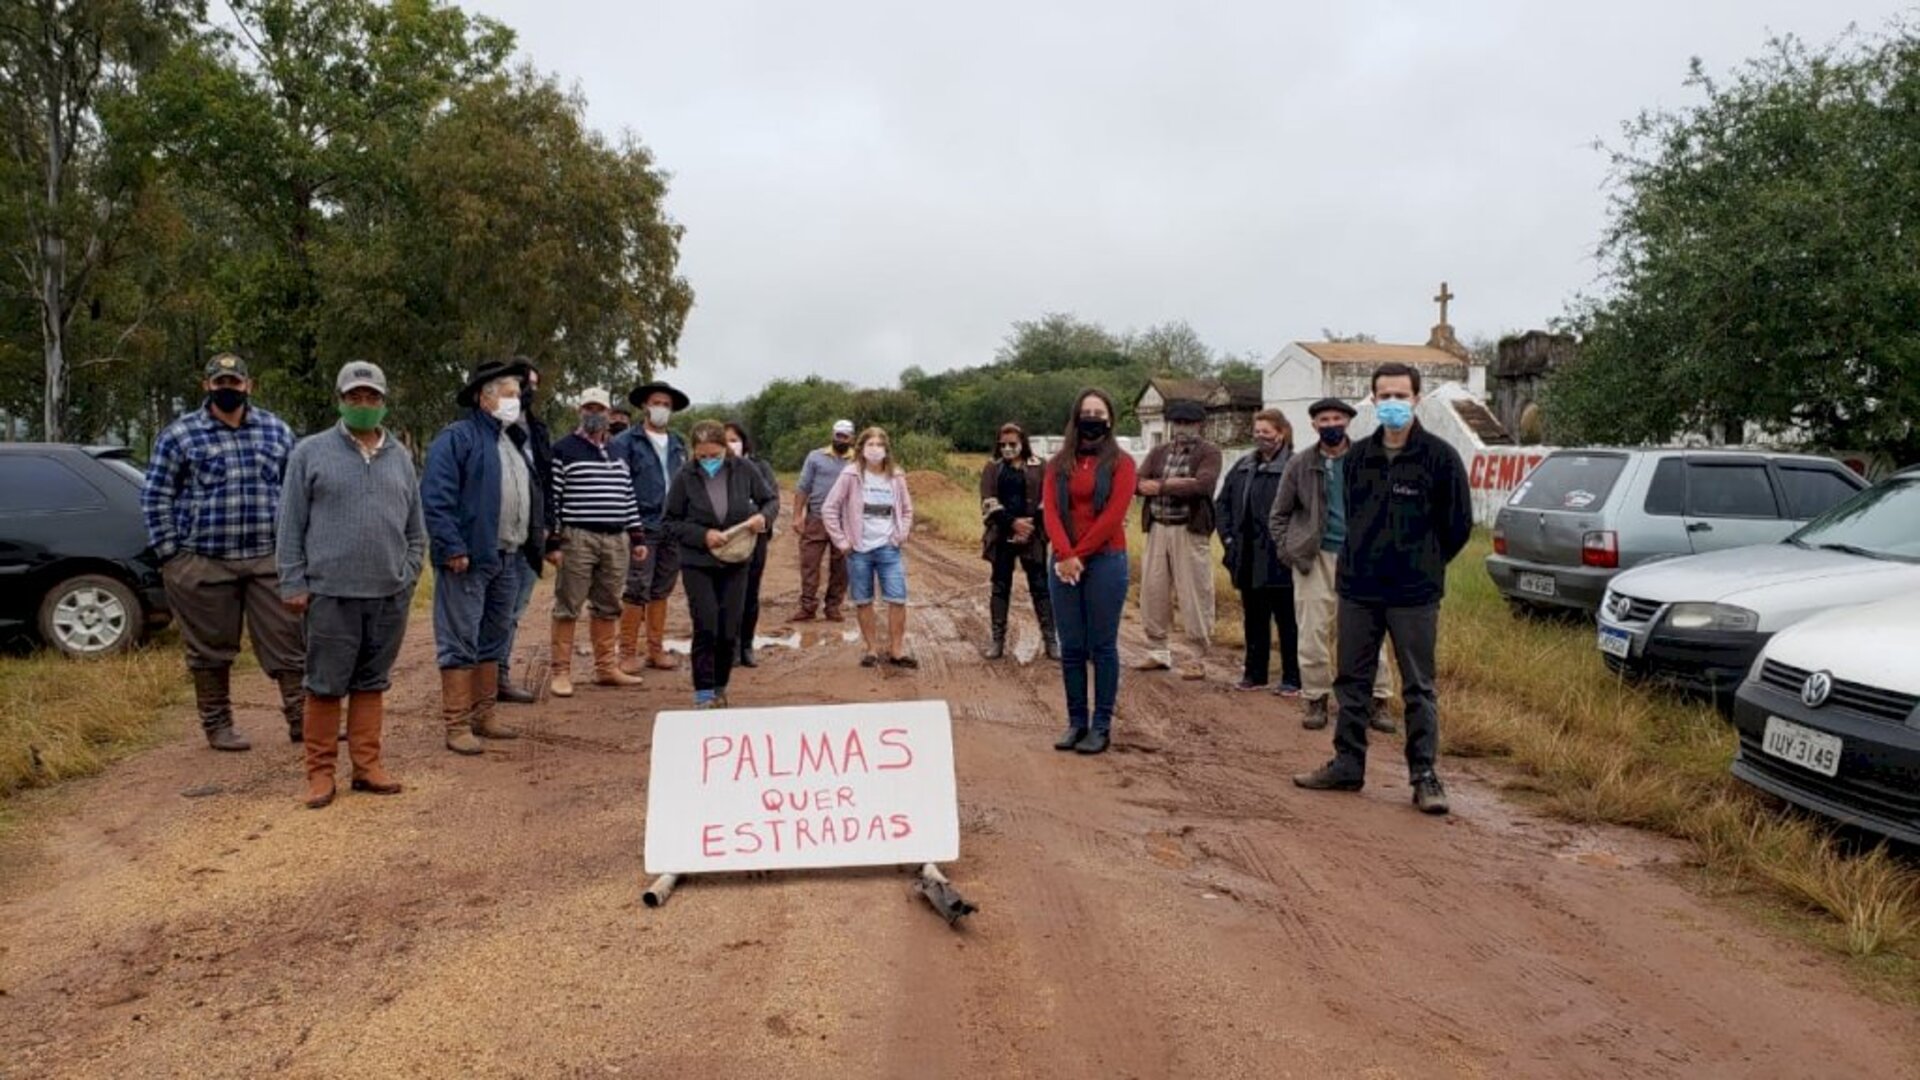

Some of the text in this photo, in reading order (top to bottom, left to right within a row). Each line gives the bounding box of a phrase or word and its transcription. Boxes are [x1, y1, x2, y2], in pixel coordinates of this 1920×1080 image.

[703, 728, 912, 784] PALMAS
[762, 786, 856, 812] QUER
[703, 814, 911, 857] ESTRADAS
